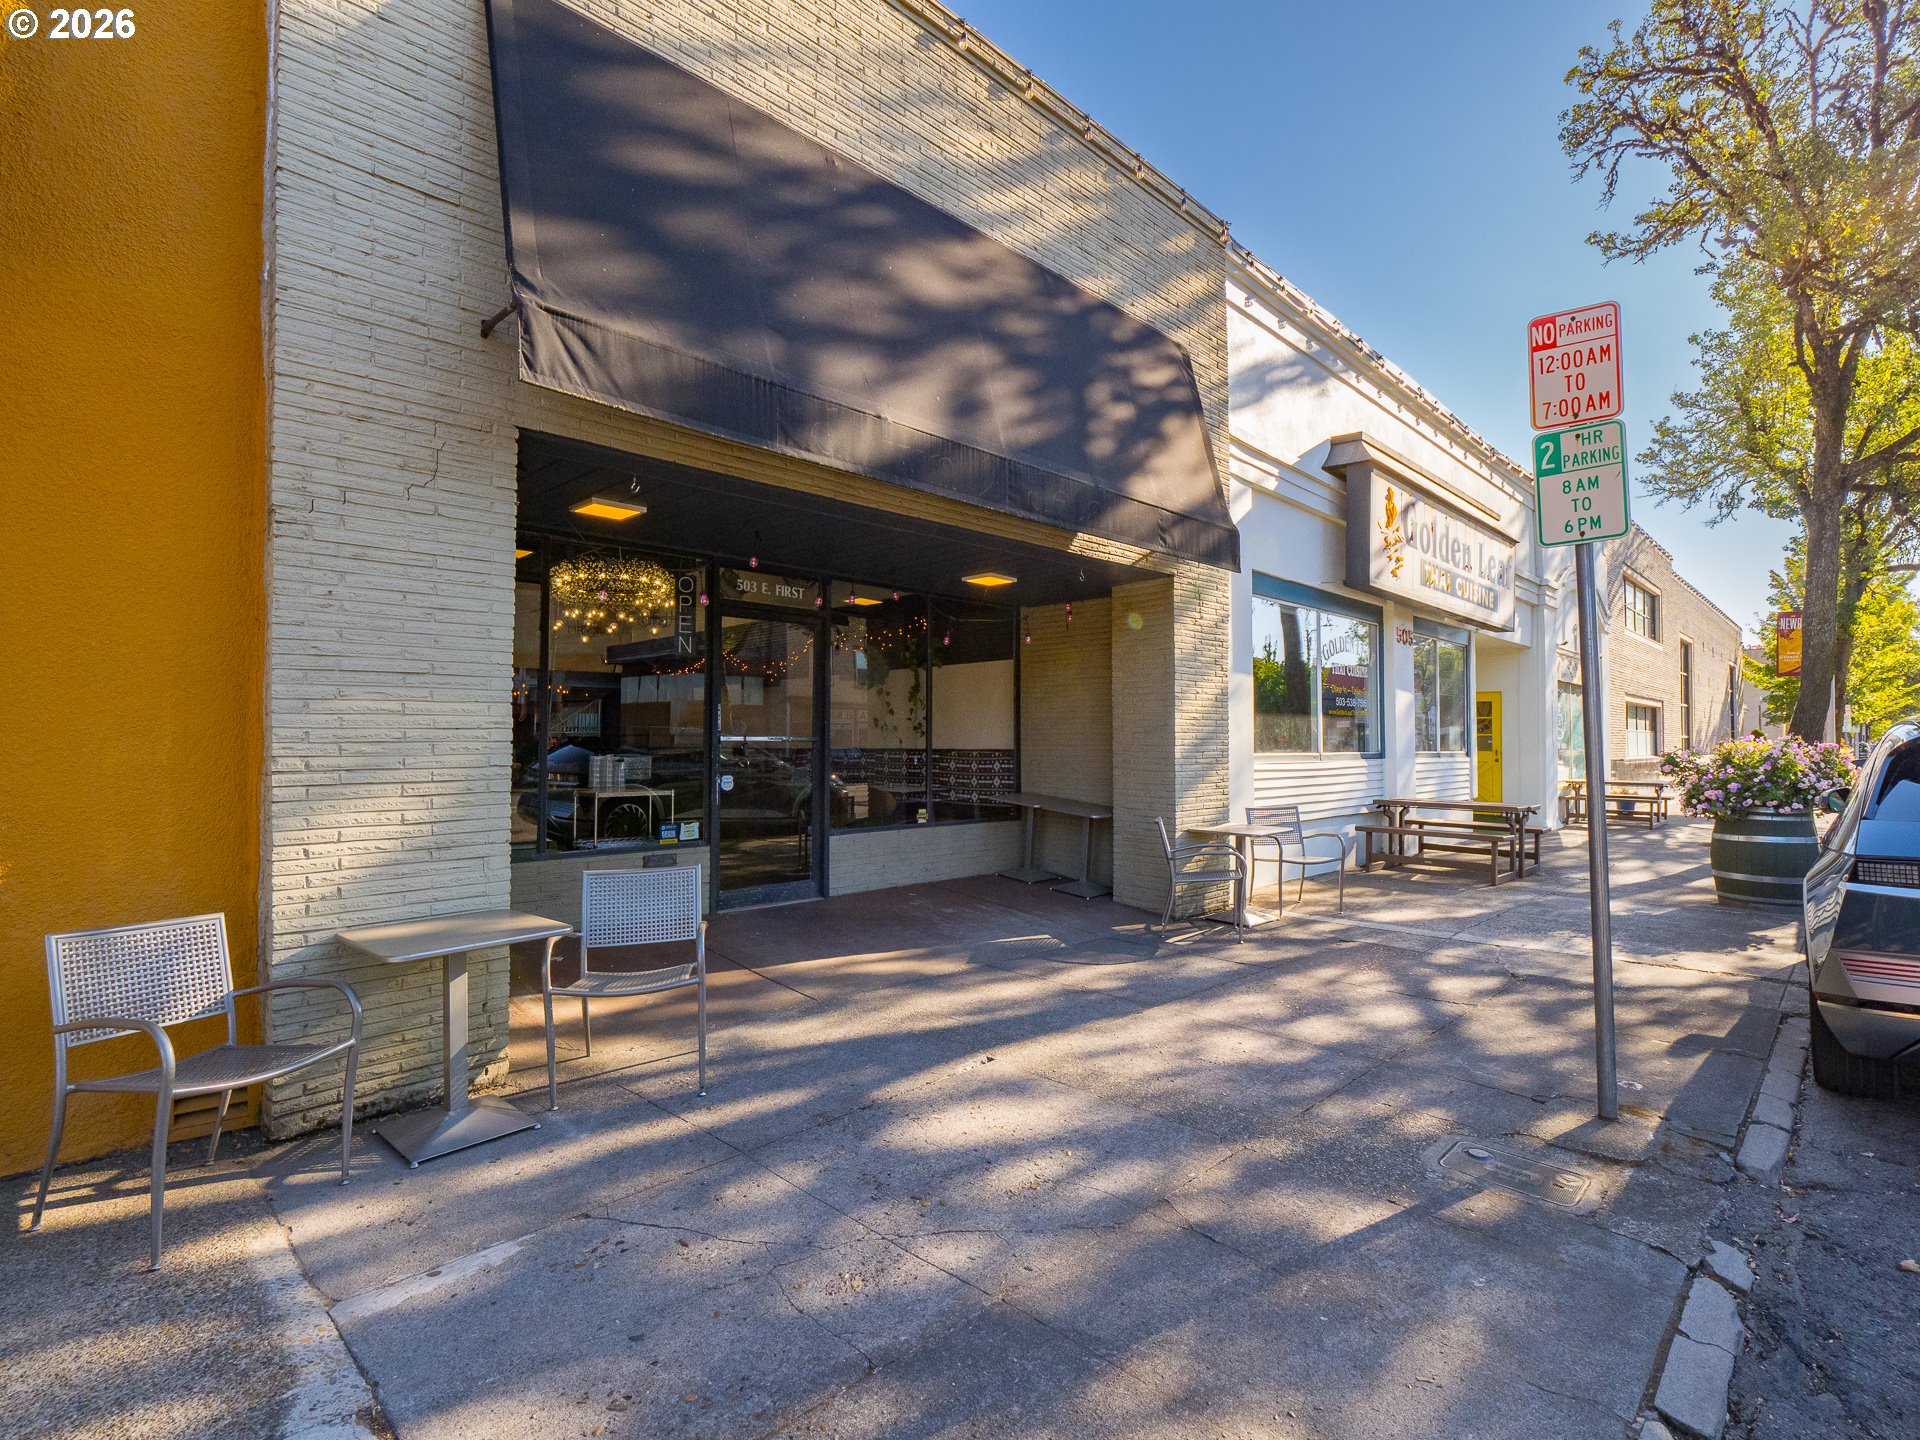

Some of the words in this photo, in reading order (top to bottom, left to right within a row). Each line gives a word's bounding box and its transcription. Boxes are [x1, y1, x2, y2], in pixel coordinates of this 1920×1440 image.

[1531, 322, 1555, 347] NO
[1559, 314, 1613, 338] PARKING
[1564, 372, 1585, 393] TO
[1543, 397, 1581, 420] 7:00
[1586, 391, 1611, 413] AM
[1540, 441, 1555, 470] 2
[1581, 429, 1603, 447] HR
[1562, 445, 1620, 469] PARKING
[1571, 496, 1592, 513] TO
[1402, 501, 1473, 574] Golden
[1478, 542, 1514, 590] Leaf
[736, 579, 757, 593] 503
[761, 582, 771, 595] E.
[775, 584, 805, 600] FIRST
[1424, 564, 1451, 593] THAI
[1455, 577, 1495, 609] CUISINE
[678, 576, 694, 654] OPEN
[1395, 626, 1414, 647] 505
[1331, 662, 1346, 676] THAI
[1346, 665, 1368, 678] CUISINE
